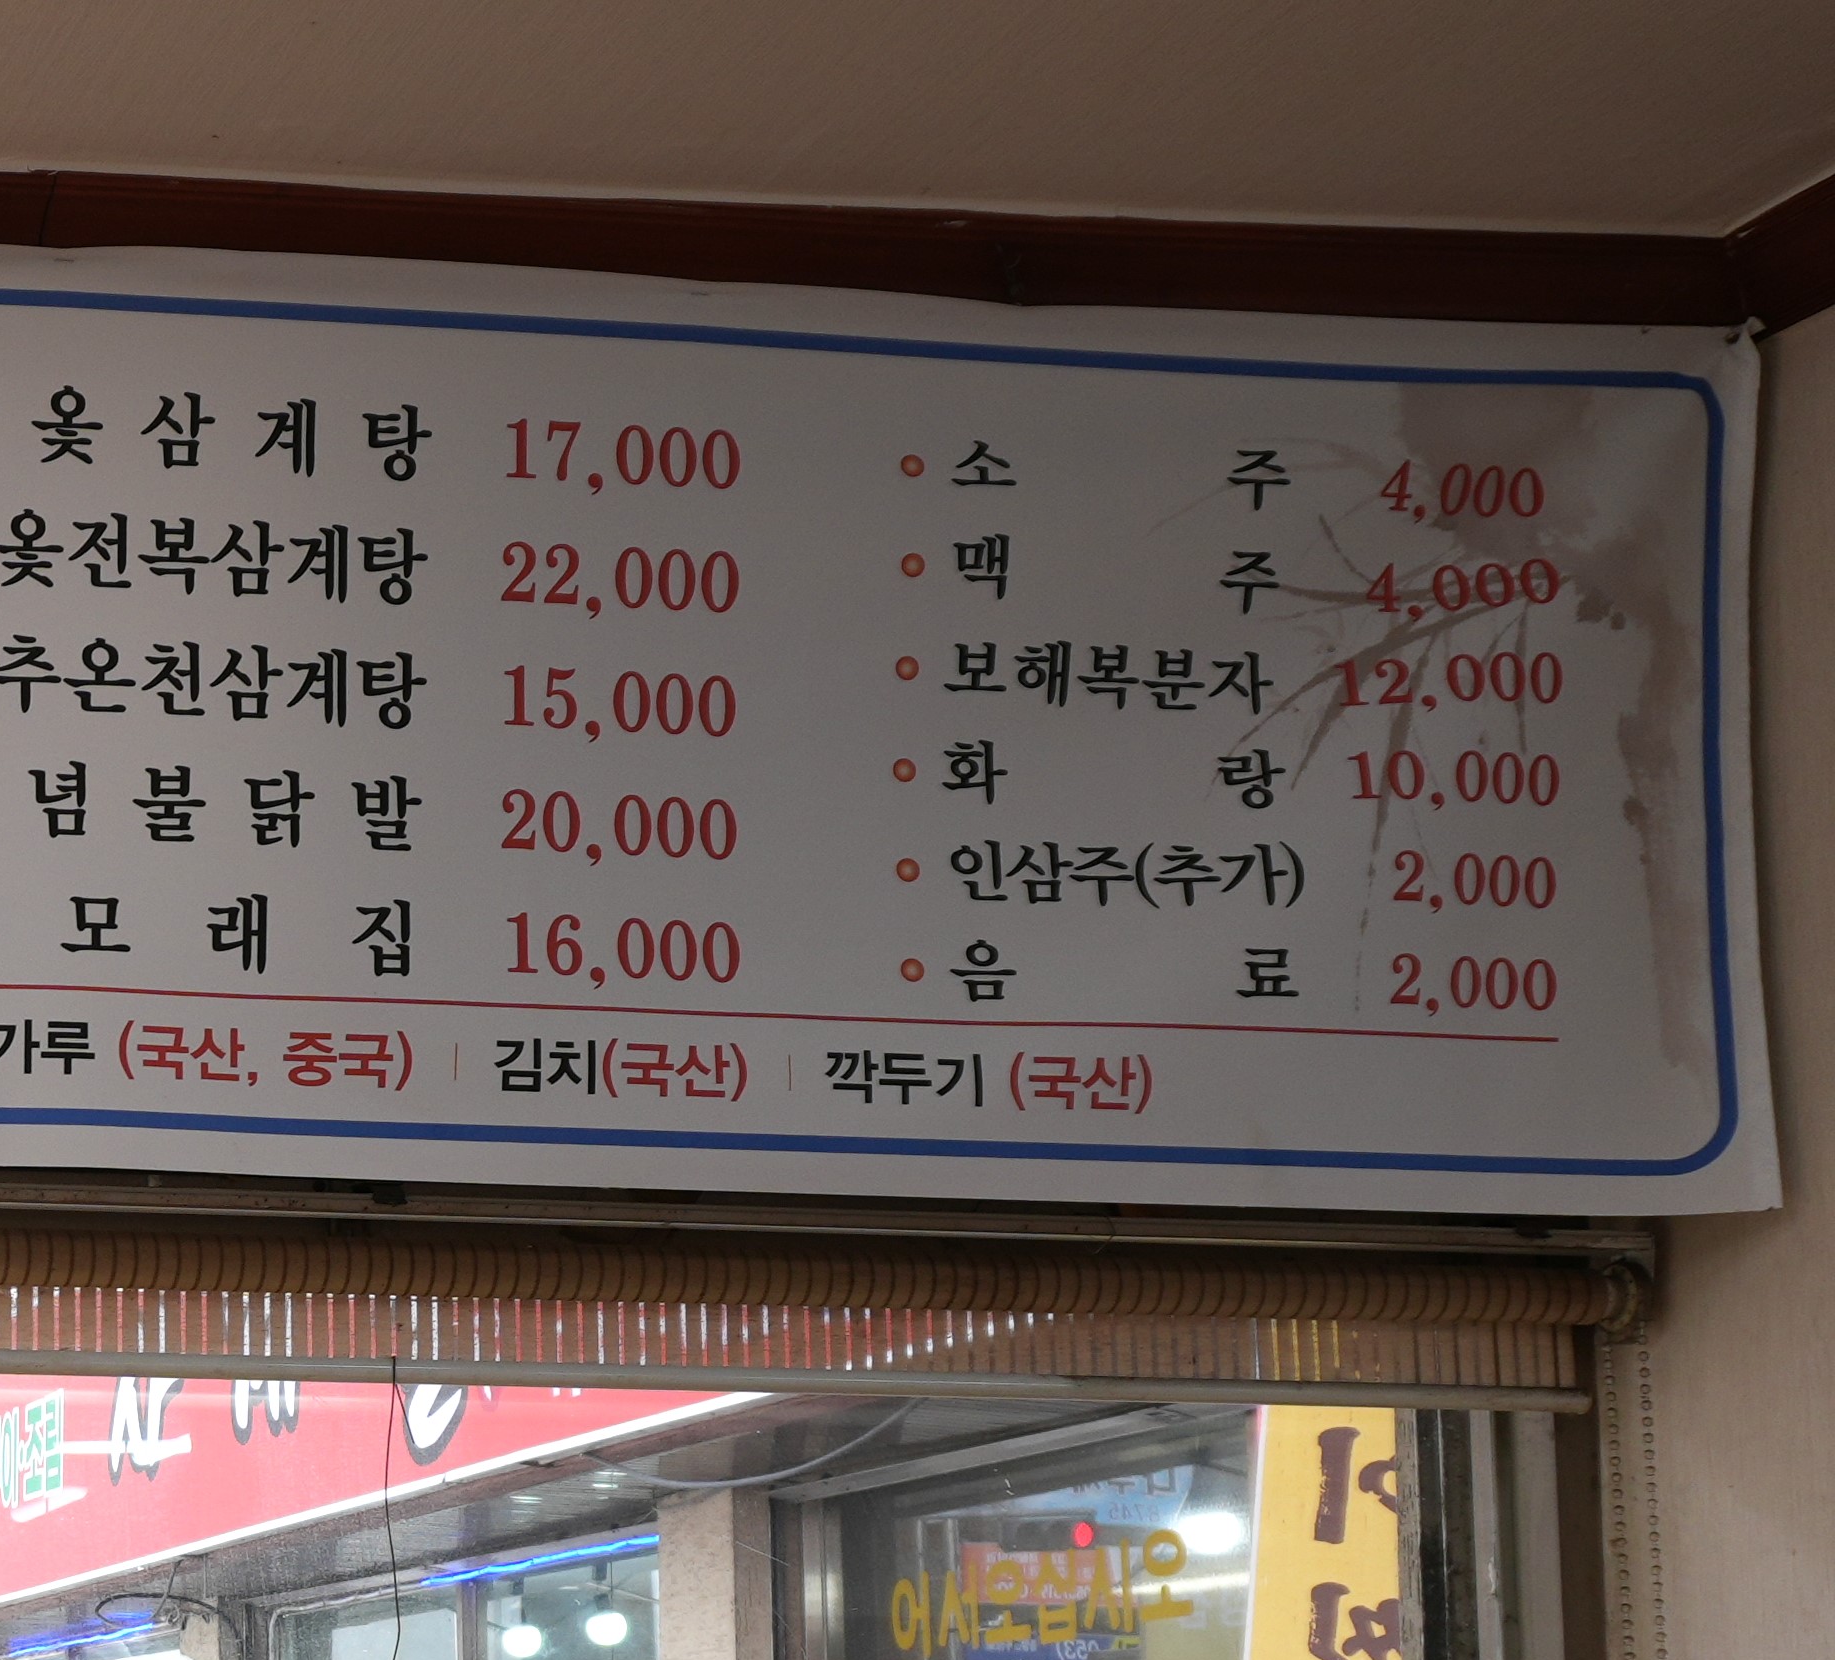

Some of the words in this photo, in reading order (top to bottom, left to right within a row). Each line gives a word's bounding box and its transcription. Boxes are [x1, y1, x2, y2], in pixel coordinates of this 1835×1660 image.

[507, 419, 740, 495] 17,000
[1379, 461, 1545, 525] 4,000
[501, 542, 739, 619] 22,000
[1365, 558, 1561, 622] 4,000
[504, 665, 735, 742] 15,000
[944, 640, 1274, 715] 보해복분자
[1337, 651, 1564, 711] 12,000
[1347, 747, 1561, 809] 10,000
[501, 789, 737, 866] 20,000
[951, 840, 1304, 909] 인삼주(추가)
[1393, 848, 1558, 913] 2,000
[507, 912, 740, 989] 16,000
[1390, 952, 1558, 1015] 2,000
[119, 1020, 257, 1087] (국산,
[283, 1031, 412, 1091] 중국)
[825, 1050, 983, 1107] 깍두기
[1010, 1052, 1152, 1114] (국산)
